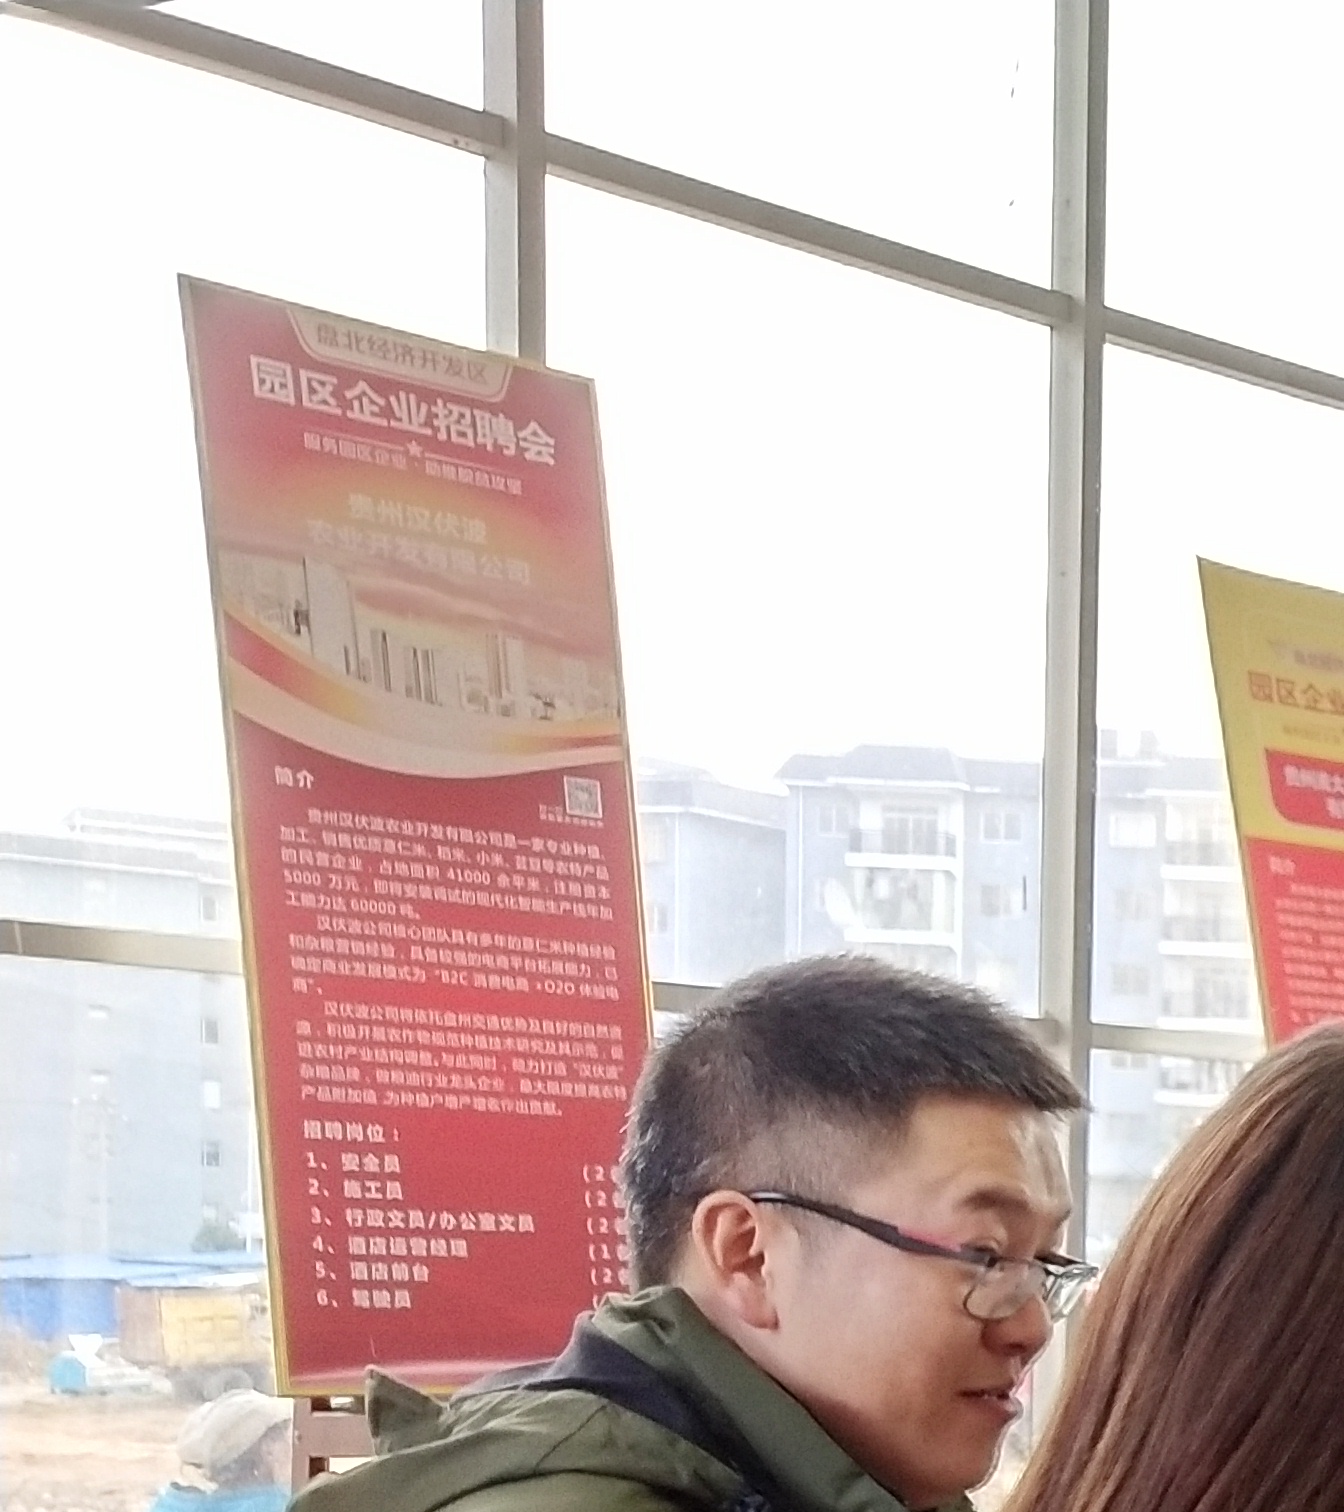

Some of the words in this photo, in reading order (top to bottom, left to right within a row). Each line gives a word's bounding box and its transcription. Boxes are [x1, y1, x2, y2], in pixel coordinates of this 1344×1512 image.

[317, 320, 489, 385] 盘北经济开发区
[250, 354, 556, 467] 园区企业招聘会
[274, 765, 315, 789] 简介
[283, 869, 323, 888] 5000
[303, 1119, 401, 1144] 招聘岗位：
